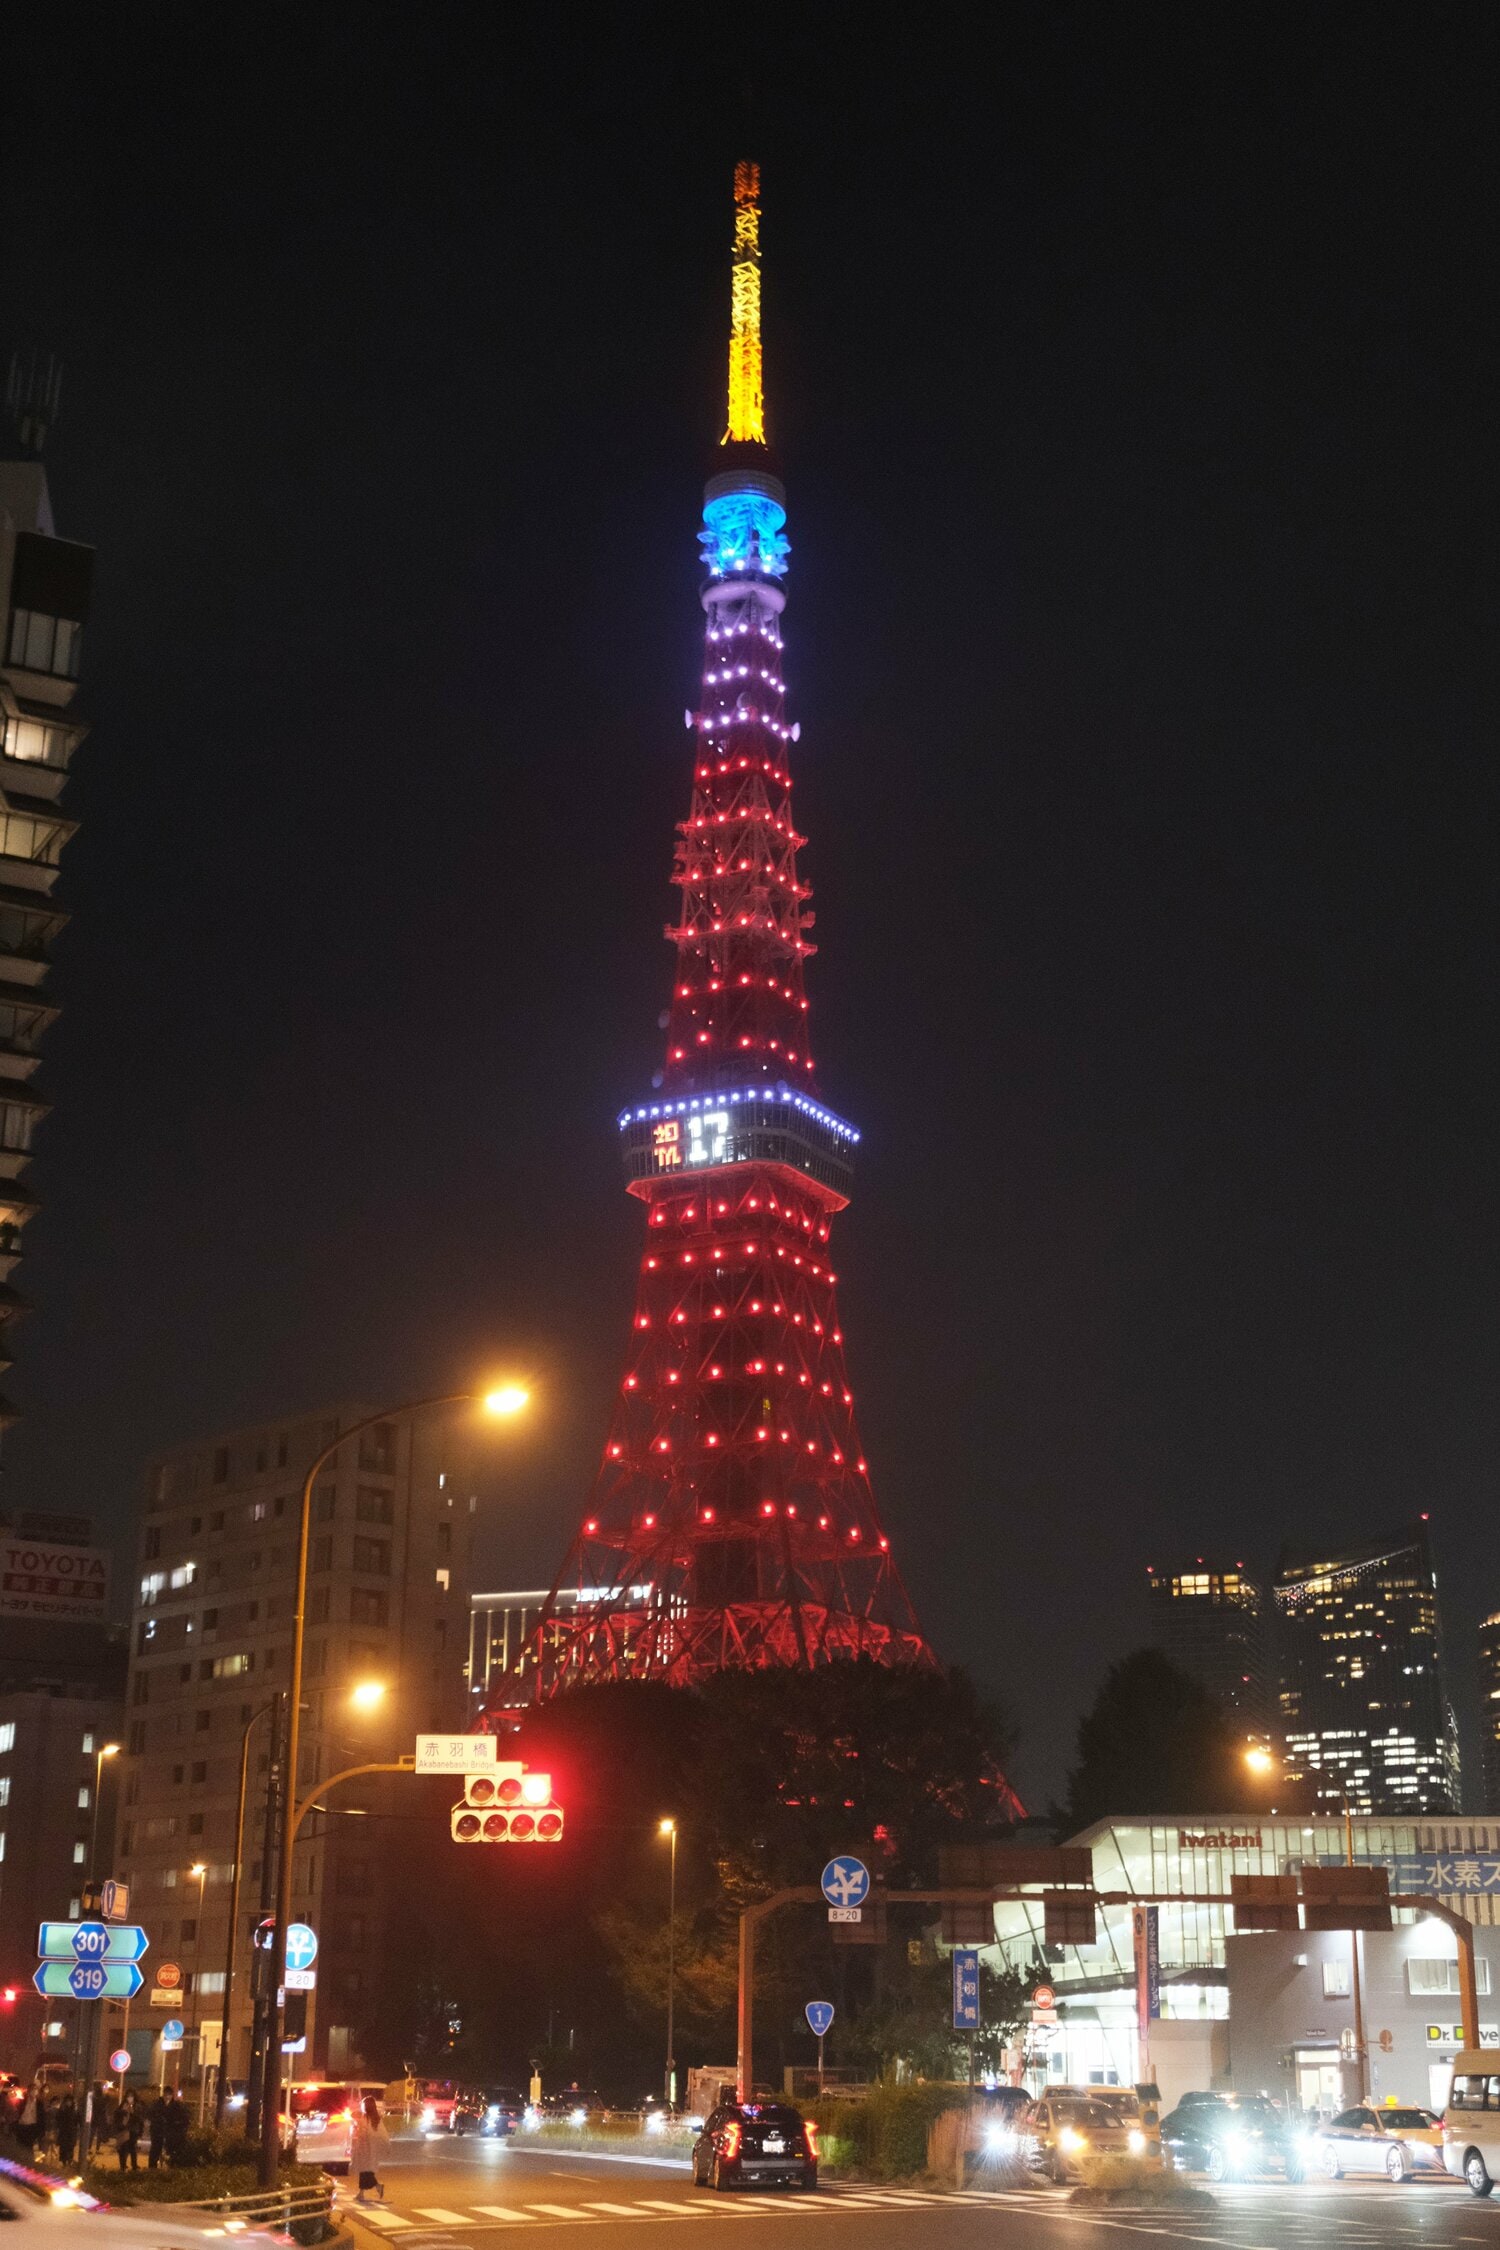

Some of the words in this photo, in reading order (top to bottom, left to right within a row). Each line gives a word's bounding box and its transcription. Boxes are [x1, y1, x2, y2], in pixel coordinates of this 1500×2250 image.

[6, 1549, 105, 1577] TOYOTA
[425, 1742, 488, 1757] 赤羽橋
[418, 1760, 468, 1769] Akabanebashi
[1180, 1831, 1263, 1848] Iwatani
[832, 1910, 858, 1920] 8-20
[76, 1931, 106, 1953] 301
[73, 1968, 103, 1989] 319
[816, 2010, 822, 2022] 1
[1427, 2025, 1450, 2041] Dr.
[1453, 2025, 1499, 2041] Dve
